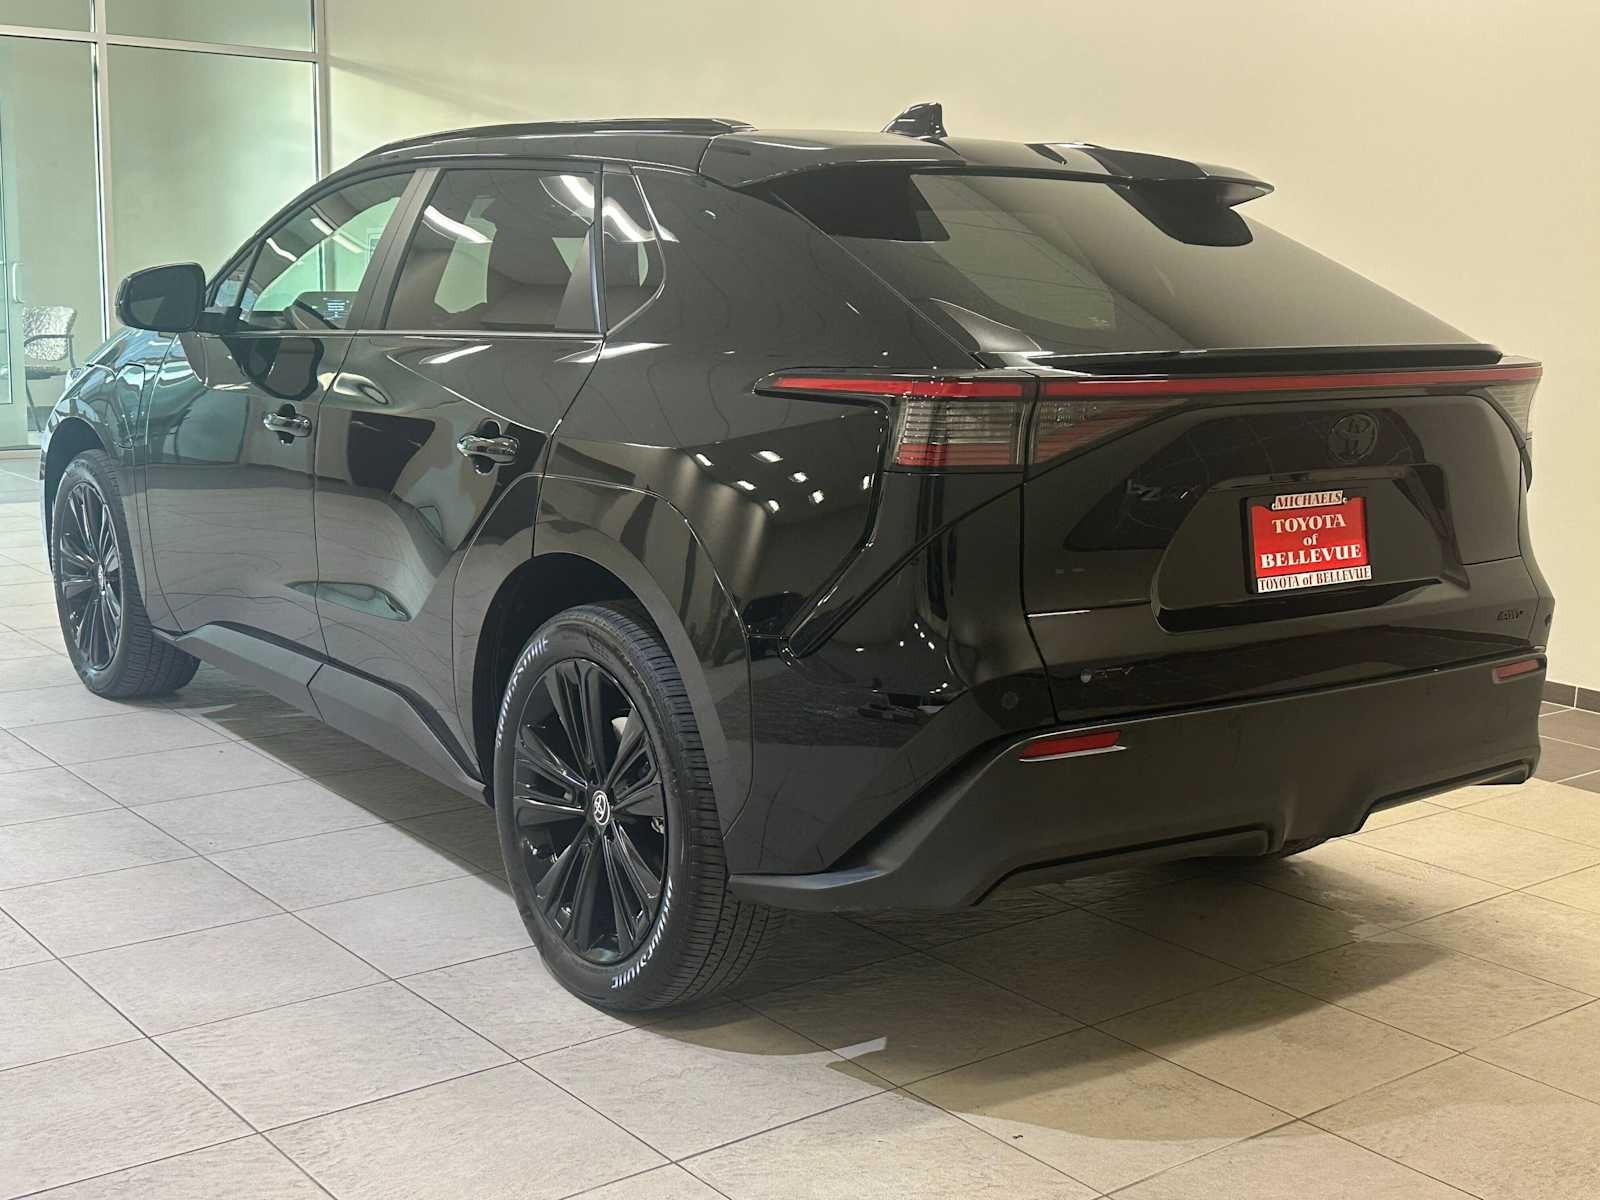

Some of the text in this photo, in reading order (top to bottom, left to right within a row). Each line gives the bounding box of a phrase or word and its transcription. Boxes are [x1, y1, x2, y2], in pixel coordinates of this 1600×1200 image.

[1275, 491, 1342, 509] MICHAELS
[1272, 514, 1346, 533] TOYOTA
[1303, 534, 1318, 546] of
[1260, 544, 1361, 569] BELLEVUE
[1259, 567, 1370, 591] TOYOTA of BELLEVUE
